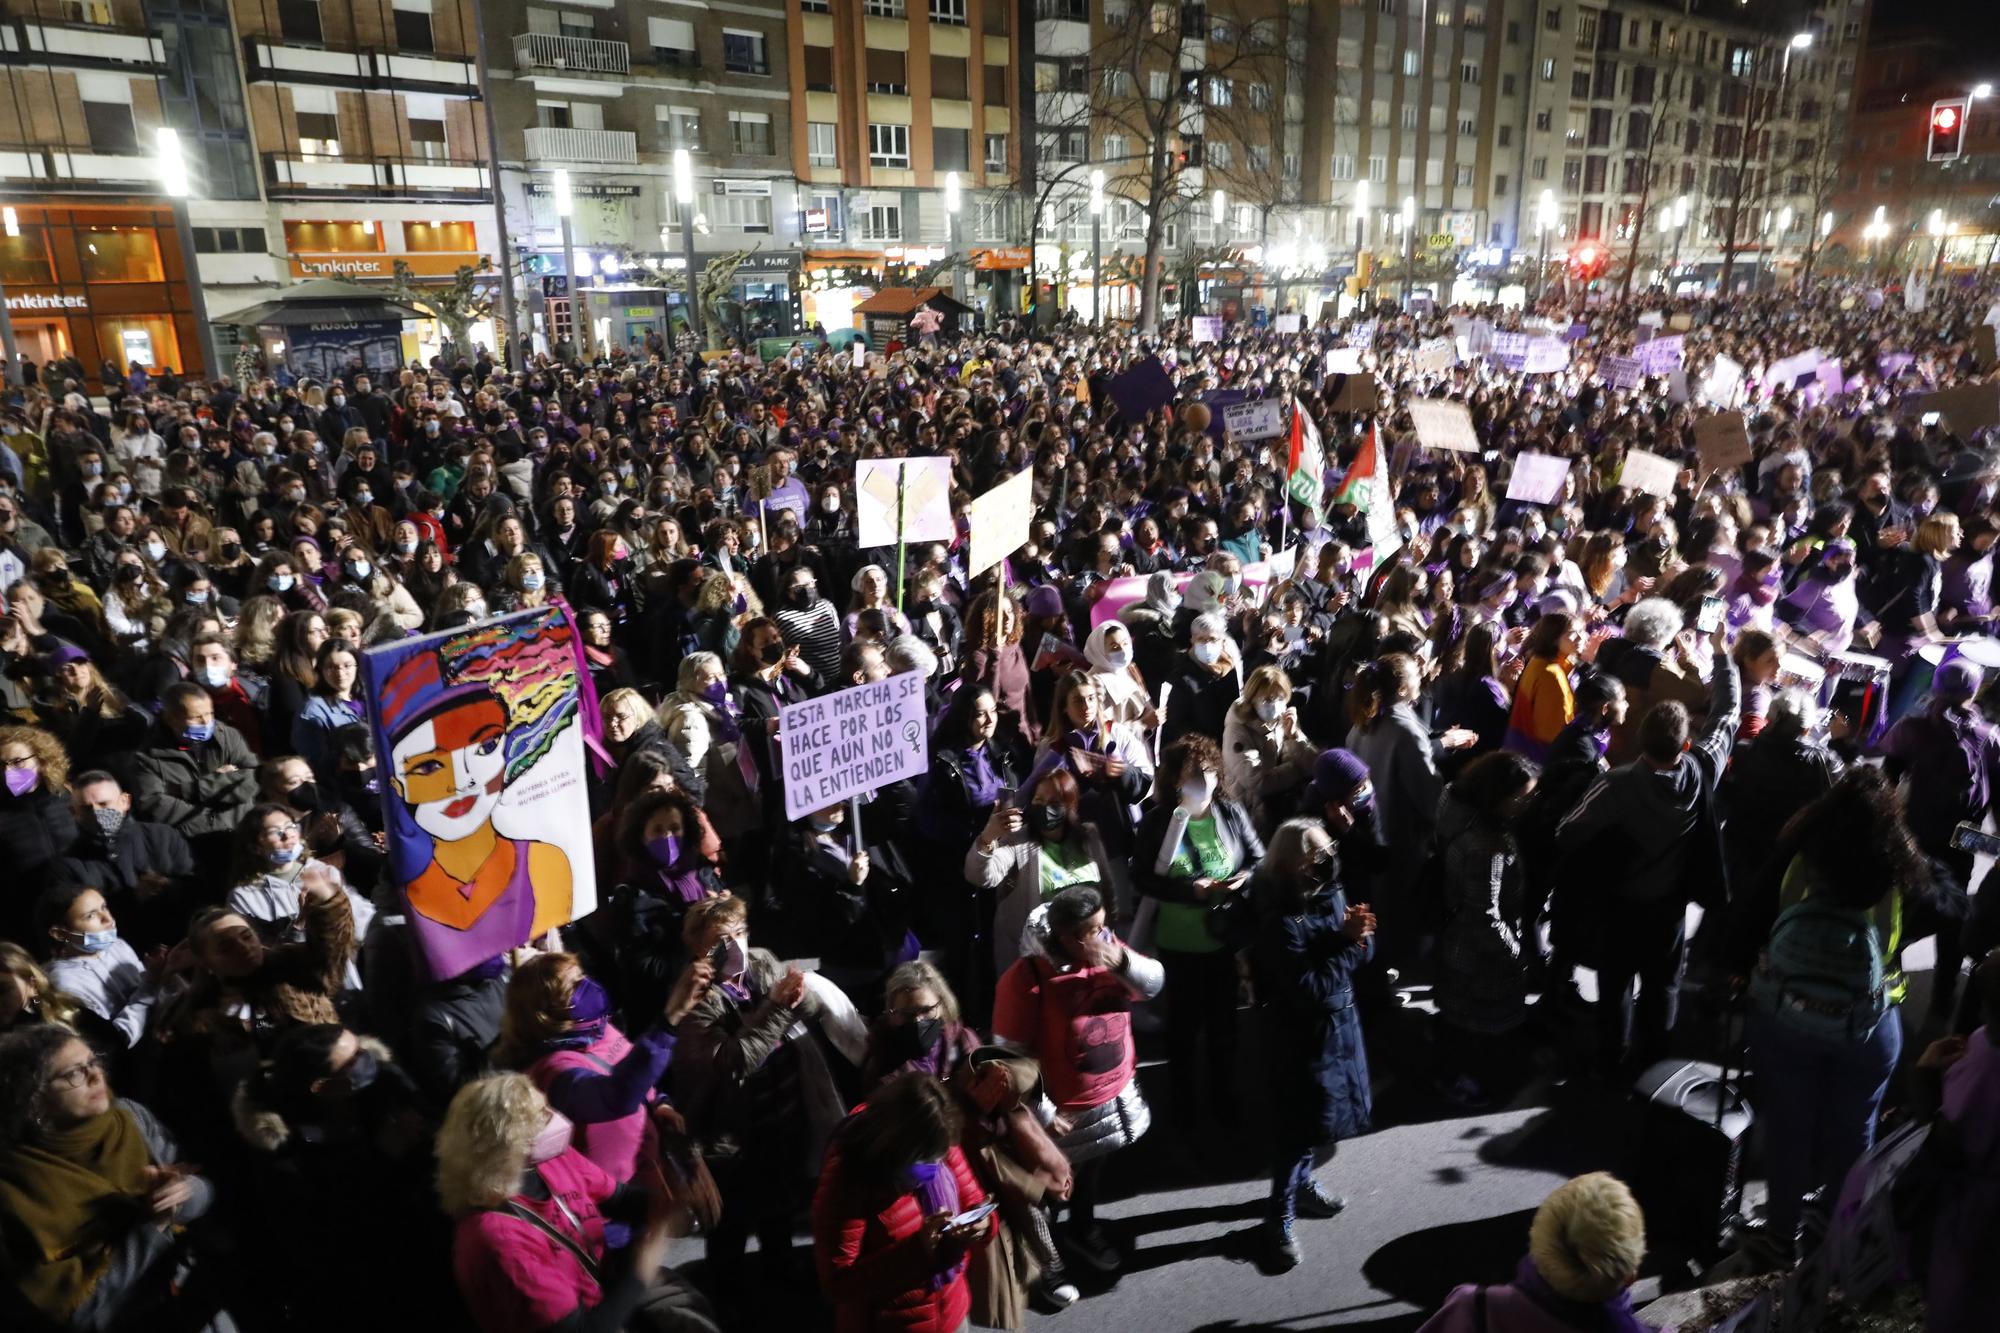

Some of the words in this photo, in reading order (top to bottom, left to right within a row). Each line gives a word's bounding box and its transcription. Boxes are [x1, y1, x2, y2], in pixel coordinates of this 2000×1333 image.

[764, 258, 790, 266] PARK
[1429, 233, 1454, 246] ORO
[787, 703, 825, 730] ESTA
[834, 684, 891, 716] MARCHA
[899, 677, 918, 698] SE
[791, 724, 832, 756] HACE
[840, 714, 868, 739] POR
[876, 703, 902, 727] LOS
[791, 753, 822, 781] QUE
[831, 738, 865, 768] AÚN
[872, 729, 893, 753] NO
[793, 785, 814, 809] LA
[820, 750, 904, 798] ENTIENDEN
